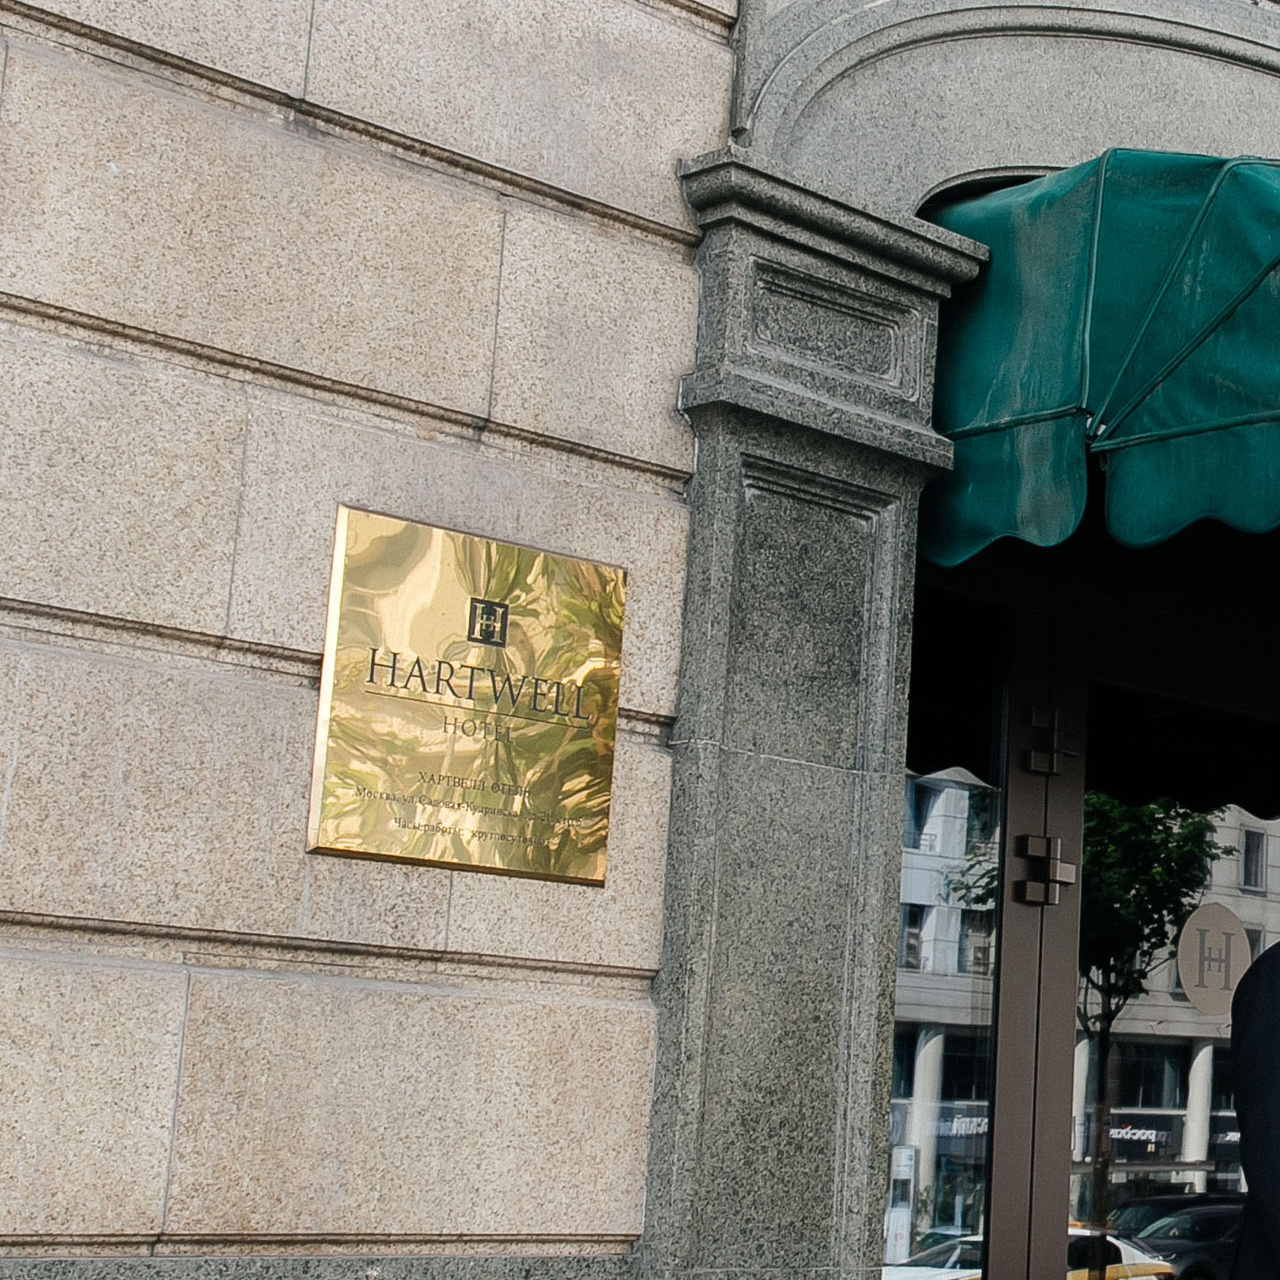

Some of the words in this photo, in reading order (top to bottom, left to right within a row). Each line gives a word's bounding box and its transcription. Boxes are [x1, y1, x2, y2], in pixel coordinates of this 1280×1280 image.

[366, 647, 592, 720] HARTWELL
[443, 716, 515, 744] HOTEL
[418, 771, 485, 792] ХАРТВЕЛЛ
